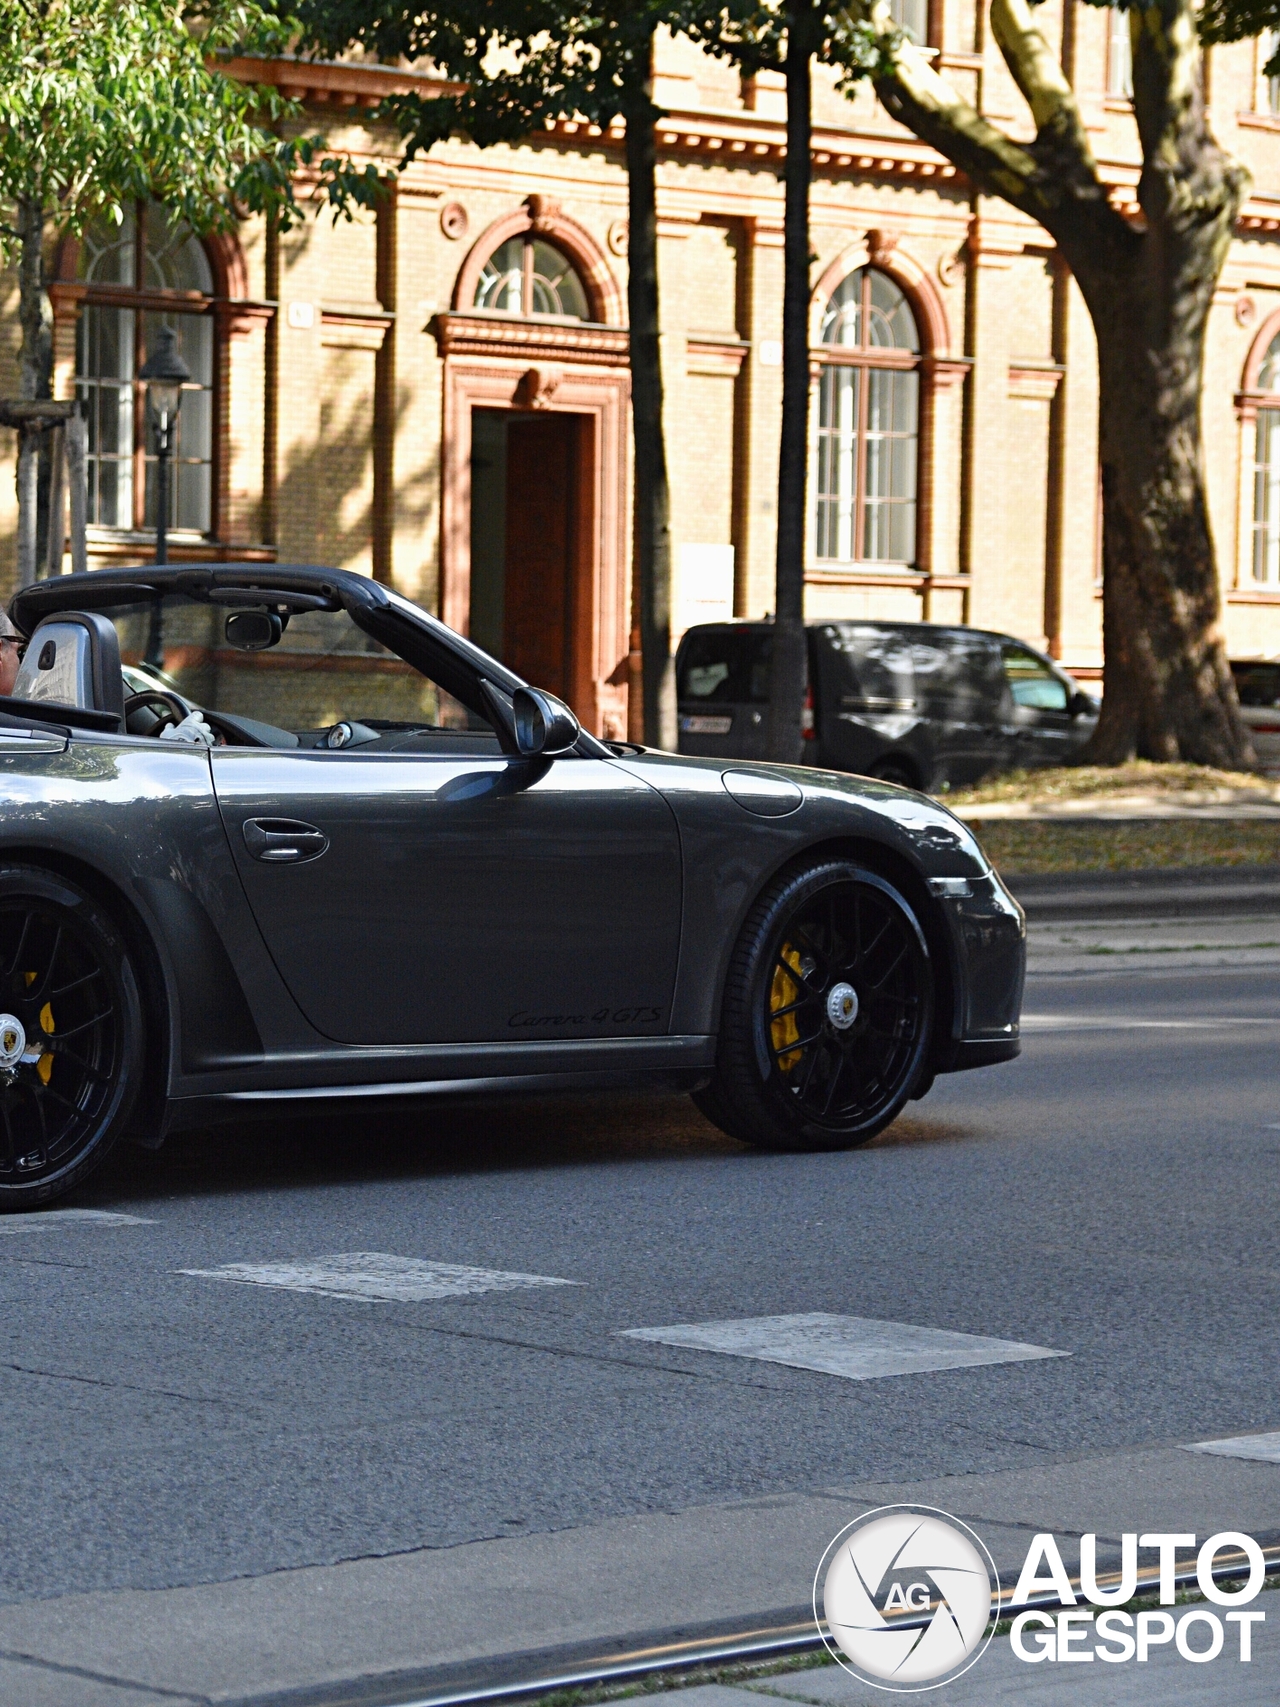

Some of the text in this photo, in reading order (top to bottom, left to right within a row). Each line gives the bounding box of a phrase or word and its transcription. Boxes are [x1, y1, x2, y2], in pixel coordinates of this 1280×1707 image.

[508, 1006, 664, 1028] Carrera 4 GTS
